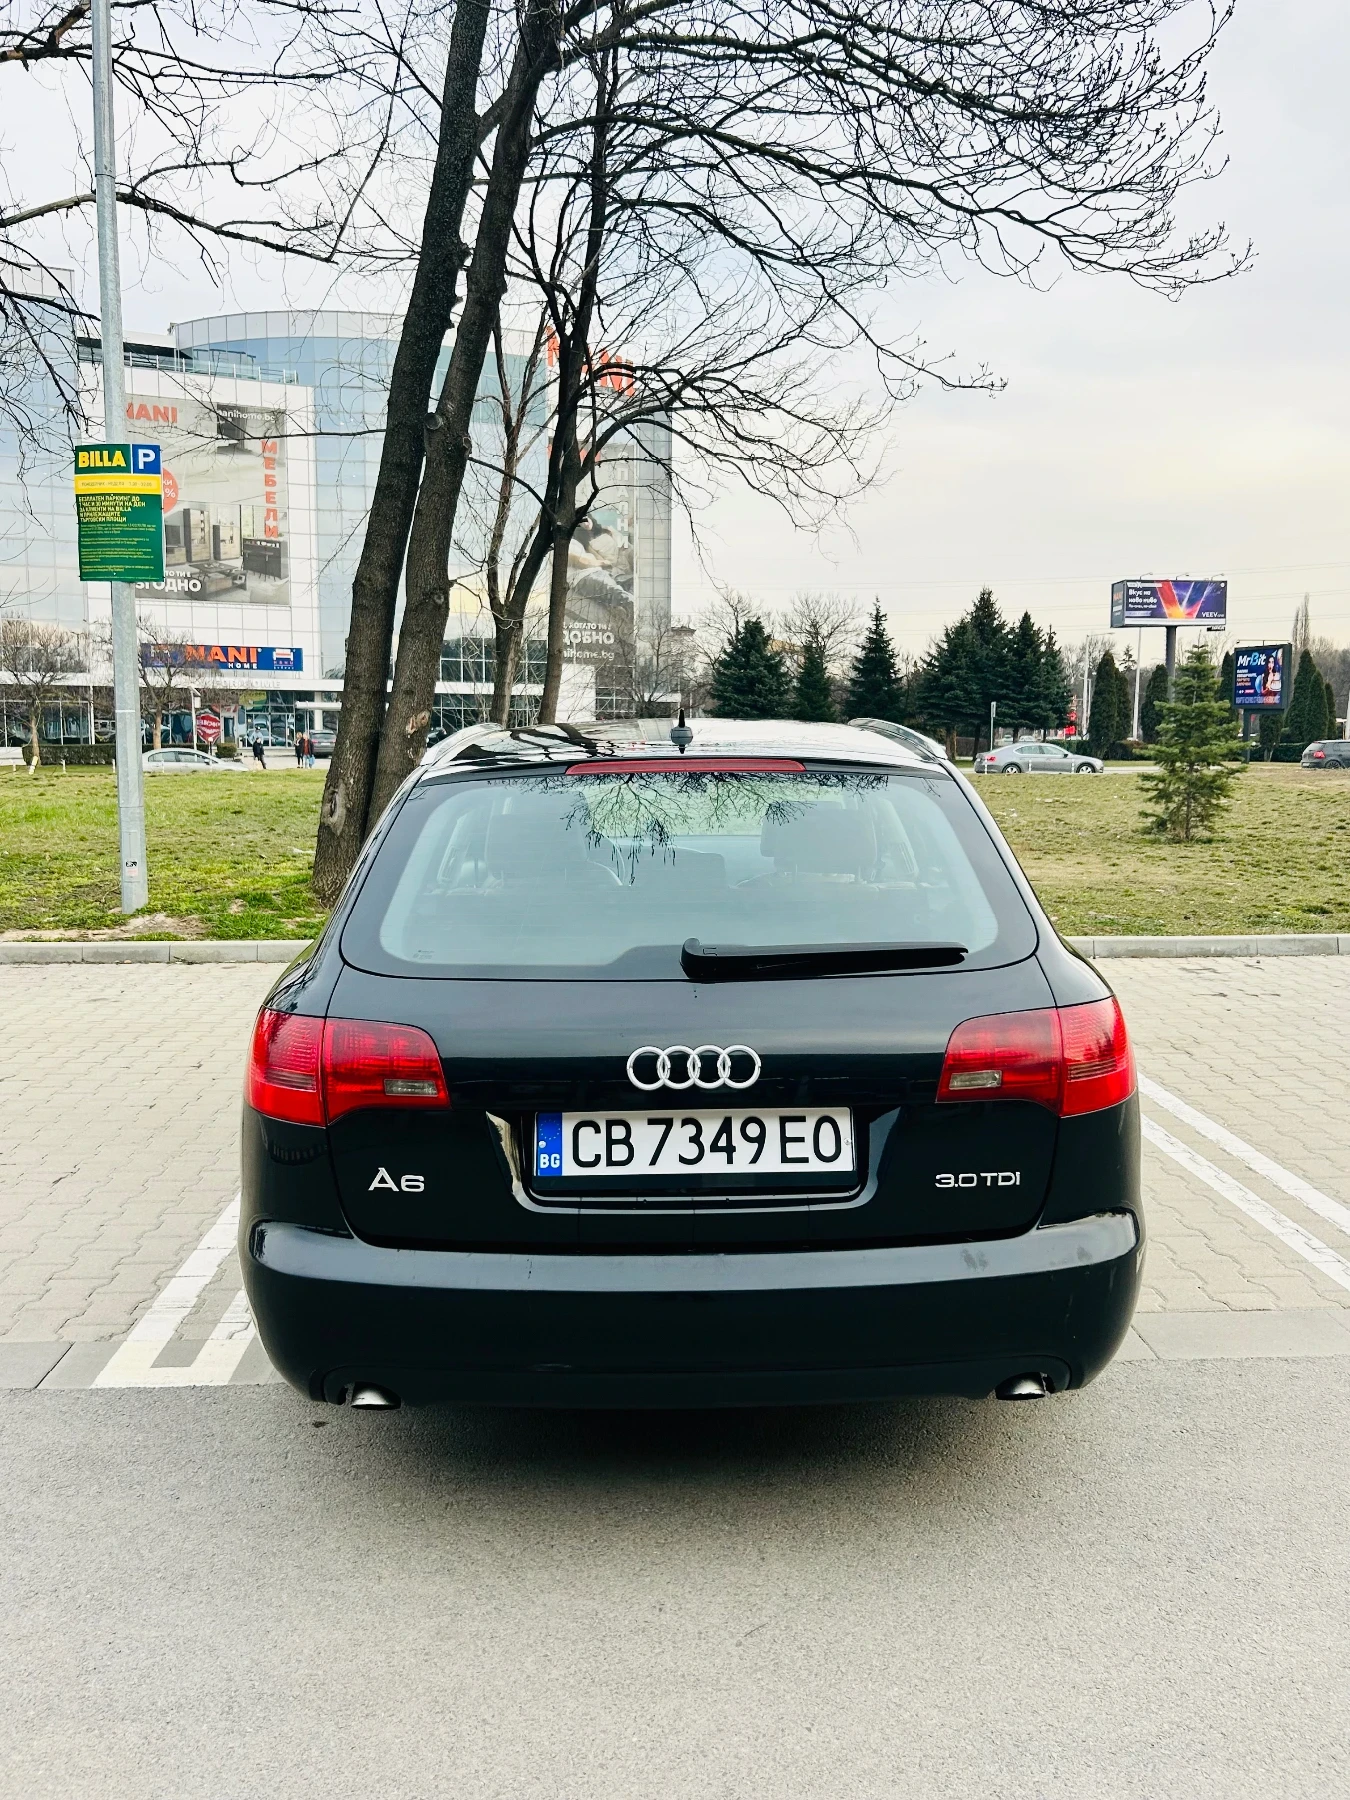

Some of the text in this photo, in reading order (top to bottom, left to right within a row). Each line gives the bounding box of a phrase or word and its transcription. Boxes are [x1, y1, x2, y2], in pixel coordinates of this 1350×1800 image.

[78, 450, 127, 468] BILLA
[137, 448, 156, 470] P
[260, 440, 279, 538] МЕБЕЛИ
[185, 644, 258, 663] MANI
[1237, 652, 1267, 667] MrBit
[571, 1119, 635, 1169] CB
[647, 1116, 767, 1167] 7349
[539, 1153, 561, 1169] BG
[368, 1167, 425, 1193] A6
[934, 1171, 1021, 1188] 3.0 TDI
